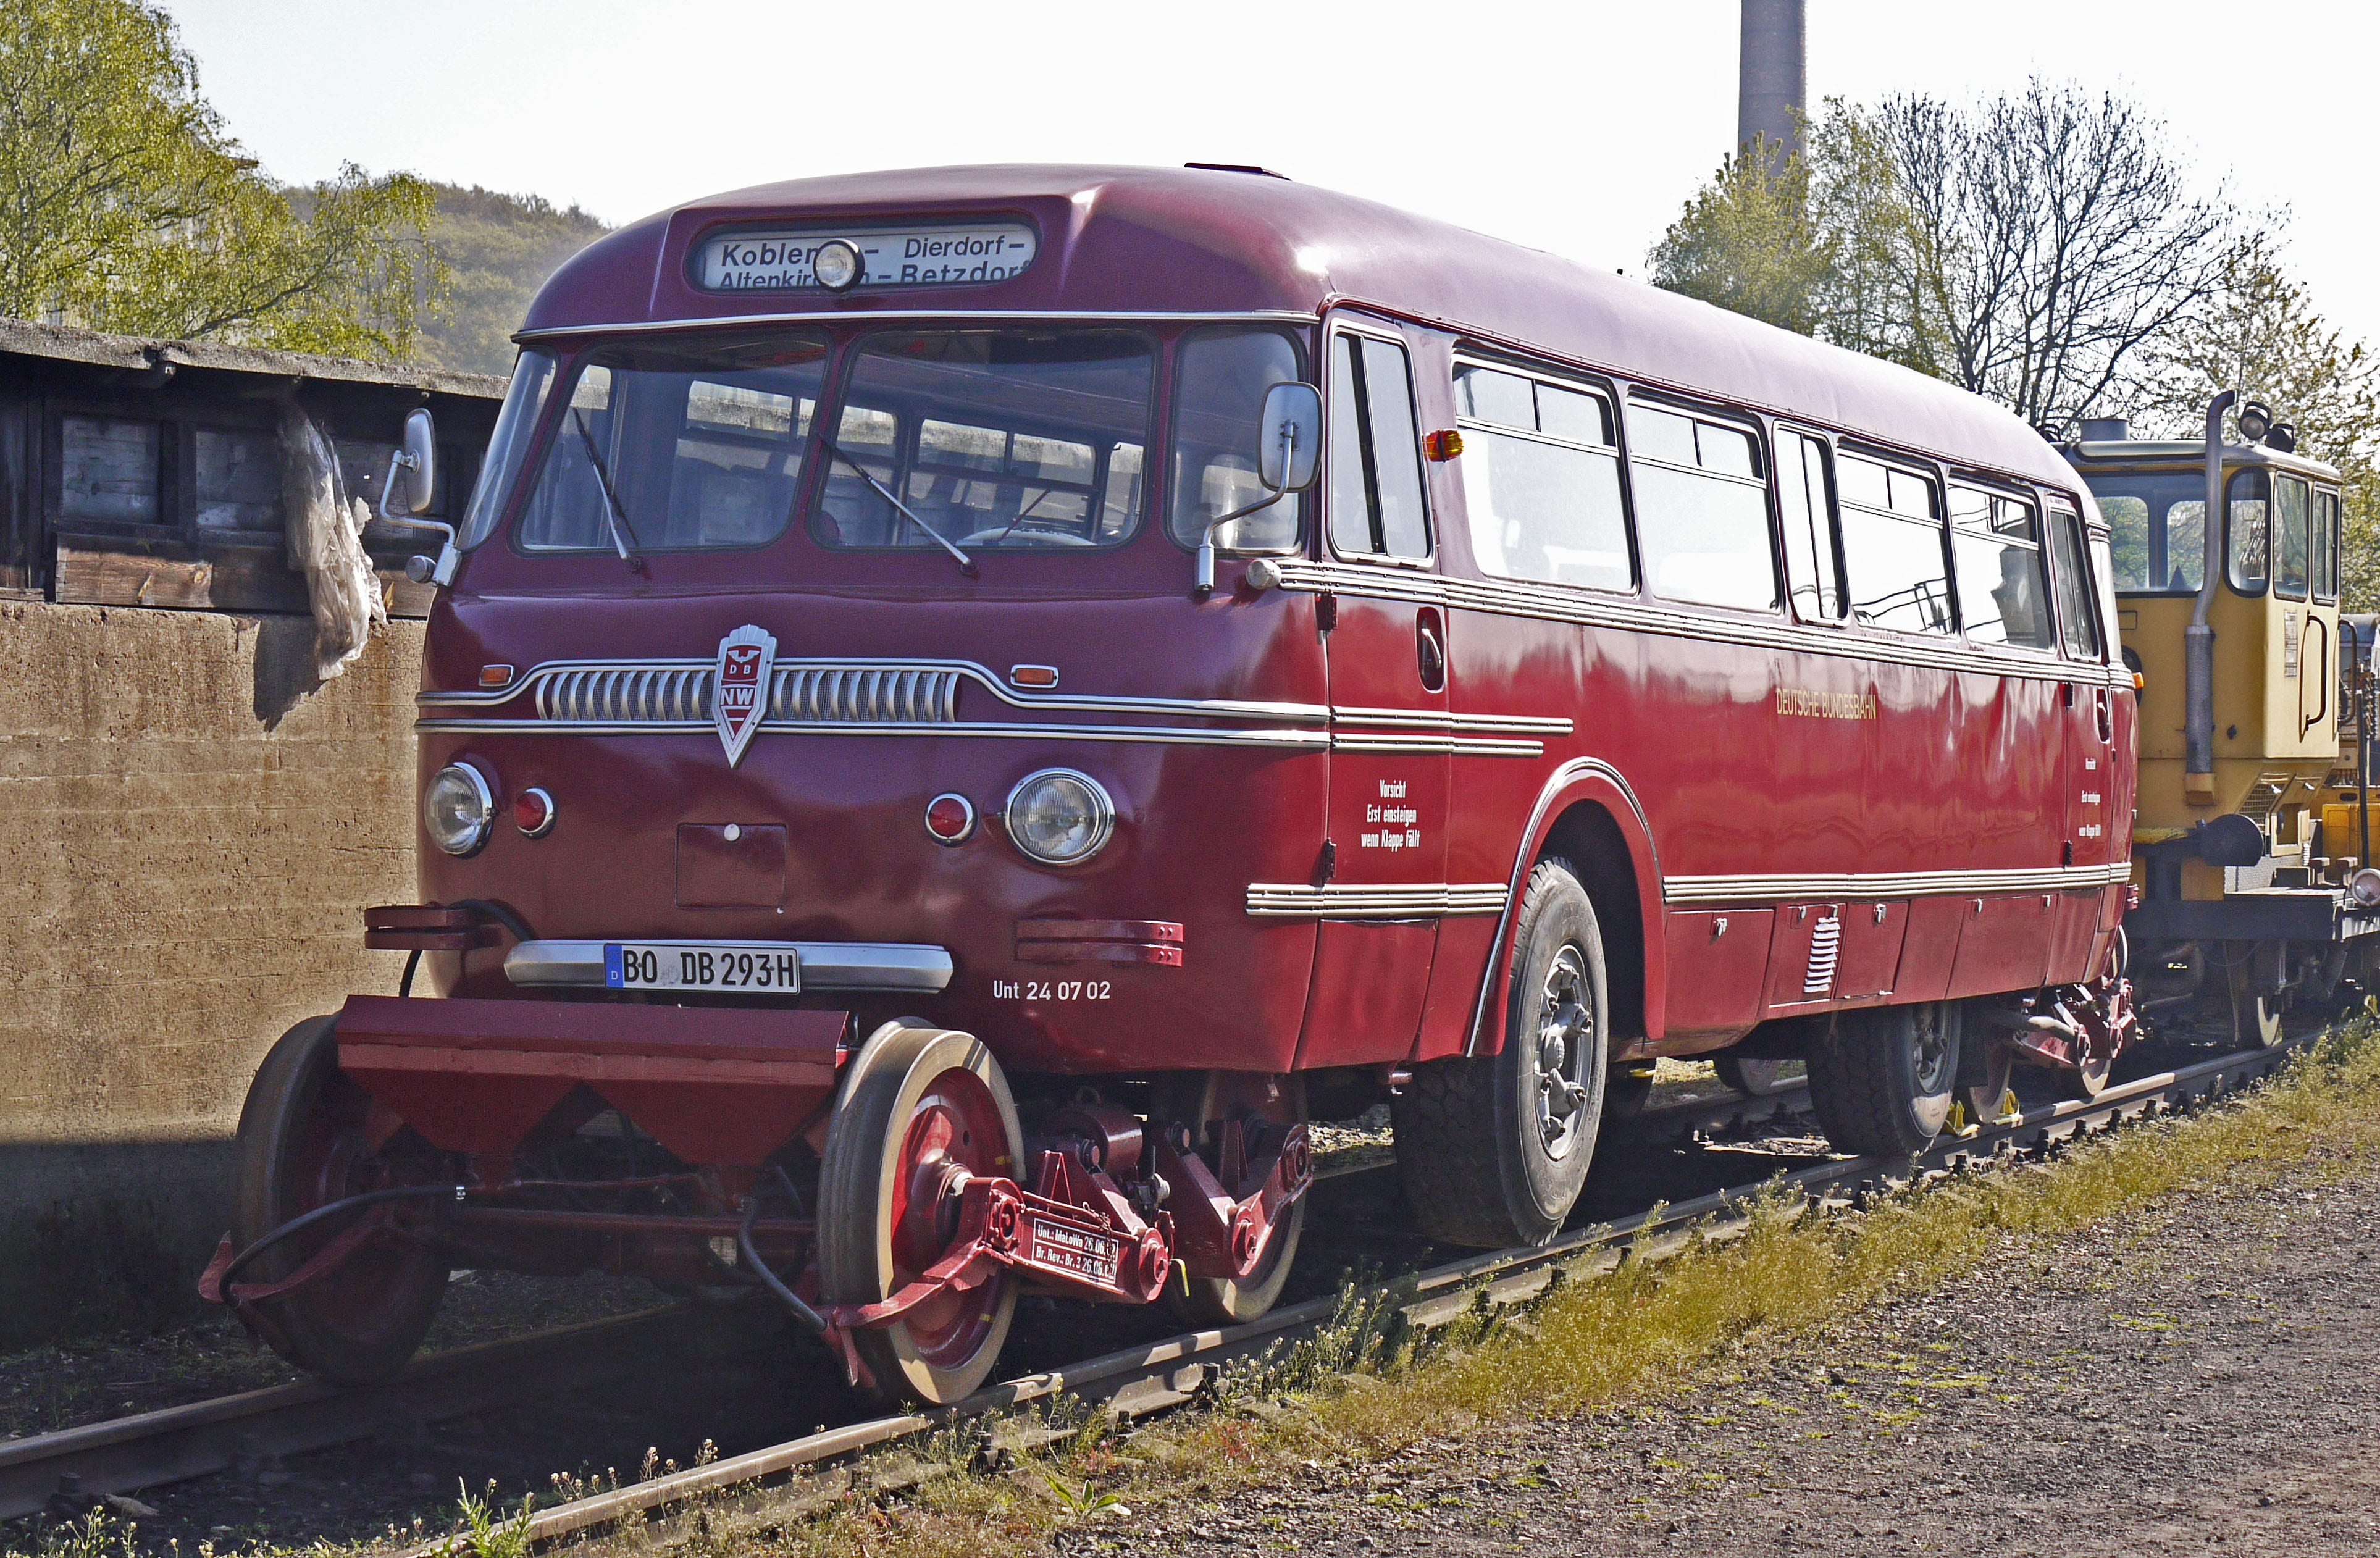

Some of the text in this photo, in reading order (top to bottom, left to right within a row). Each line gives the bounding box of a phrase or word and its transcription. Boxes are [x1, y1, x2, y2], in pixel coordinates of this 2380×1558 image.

[721, 243, 821, 267] Koblen
[1776, 687, 1877, 720] DEUTSCHE BUNDESBAHN
[1380, 779, 1406, 798] Vorsicht
[1367, 803, 1417, 827] Erst einsteigen
[1361, 834, 1379, 847] wenn
[1381, 829, 1404, 852] Klappe
[611, 971, 618, 979] D
[623, 950, 658, 983] BO
[994, 980, 1110, 1000] Unt 24 07 02
[1055, 1229, 1083, 1248] MaLoWa
[1036, 1245, 1046, 1260] Br.
